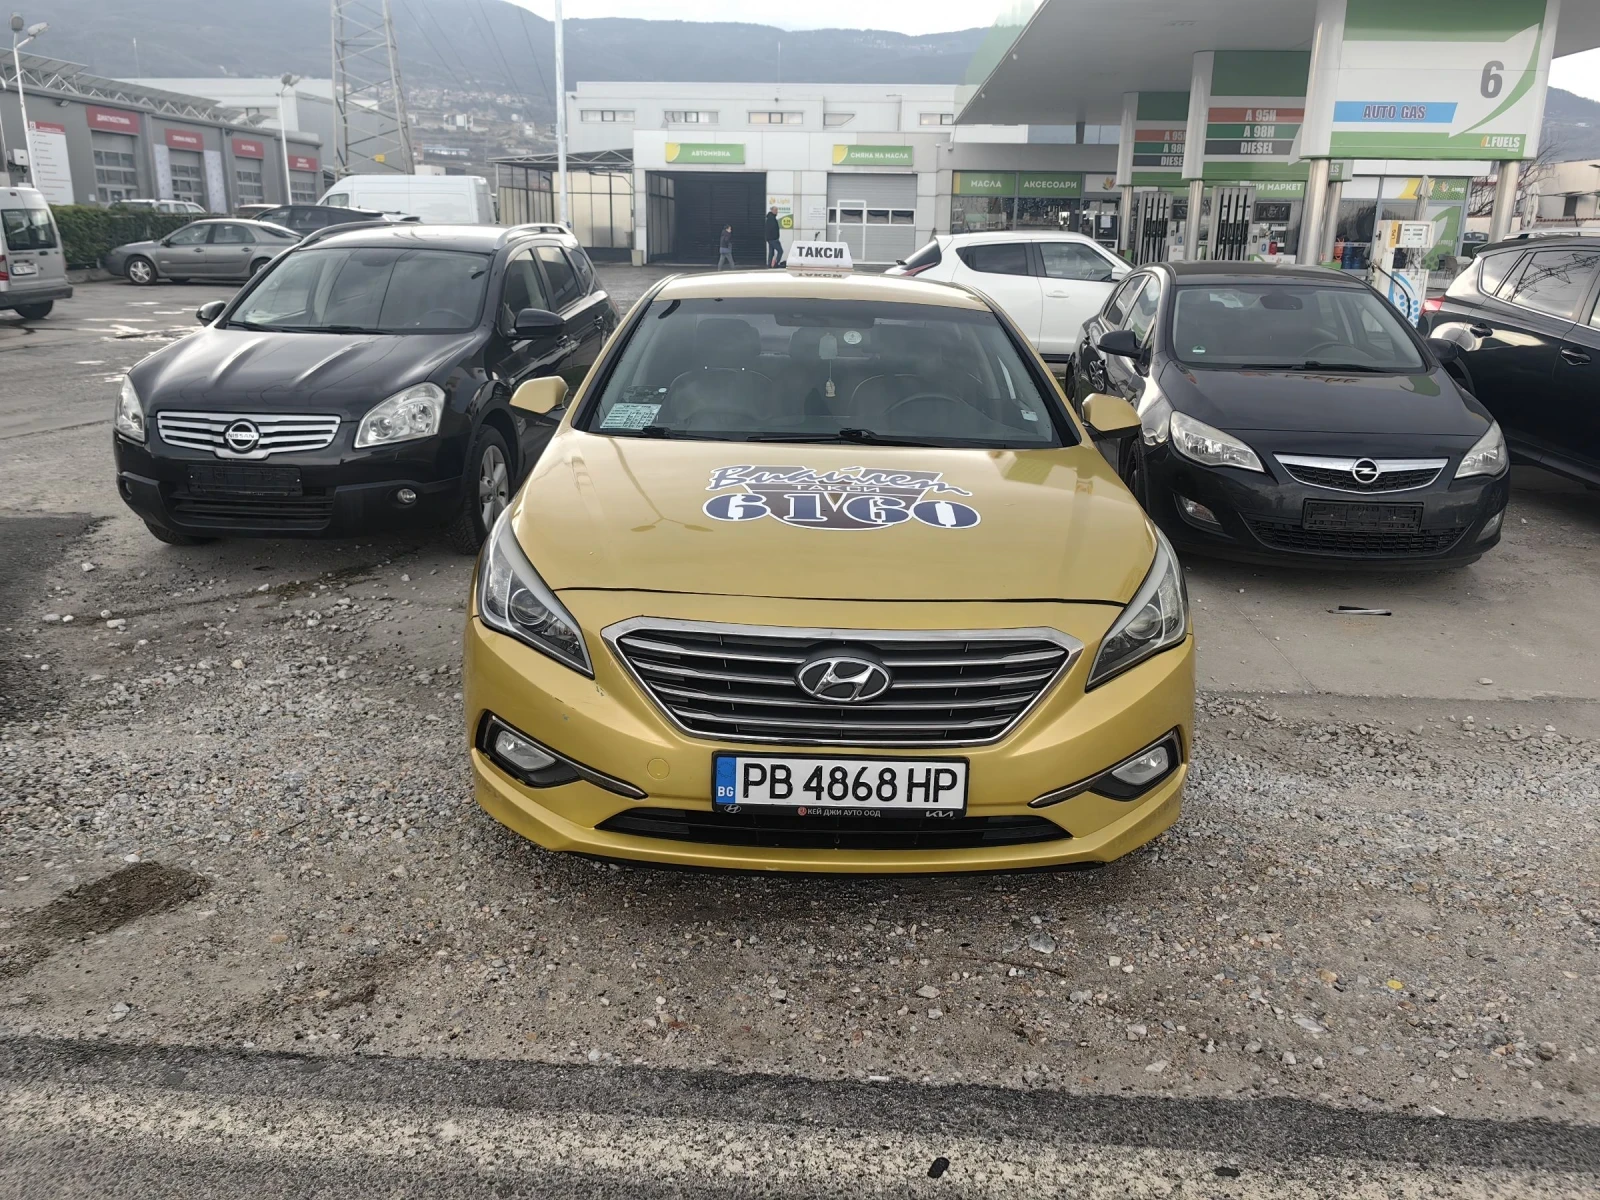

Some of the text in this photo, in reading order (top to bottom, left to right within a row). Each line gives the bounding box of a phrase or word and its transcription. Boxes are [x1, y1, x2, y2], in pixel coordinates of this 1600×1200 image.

[1480, 60, 1505, 99] 6
[1245, 109, 1277, 121] A 95H
[1362, 105, 1427, 119] AUTO GAS
[1164, 131, 1170, 141] A
[1243, 125, 1275, 137] A 98H
[1163, 143, 1169, 153] A
[1240, 142, 1274, 154] DIESEL
[850, 151, 874, 159] СМЯНА
[1160, 156, 1184, 166] DIESE
[970, 180, 1002, 188] МАСЛА
[1023, 181, 1078, 189] АКСЕСОАРИ
[1267, 183, 1302, 191] МАРКЕТ
[796, 246, 844, 259] ТАКСИ
[792, 484, 881, 494] ТАКСИ
[702, 492, 982, 529] 6160
[742, 763, 958, 802] PB 4868 HP
[717, 787, 735, 797] BG
[807, 807, 881, 818] КЕЙ ДЖИ АУТО ООД
